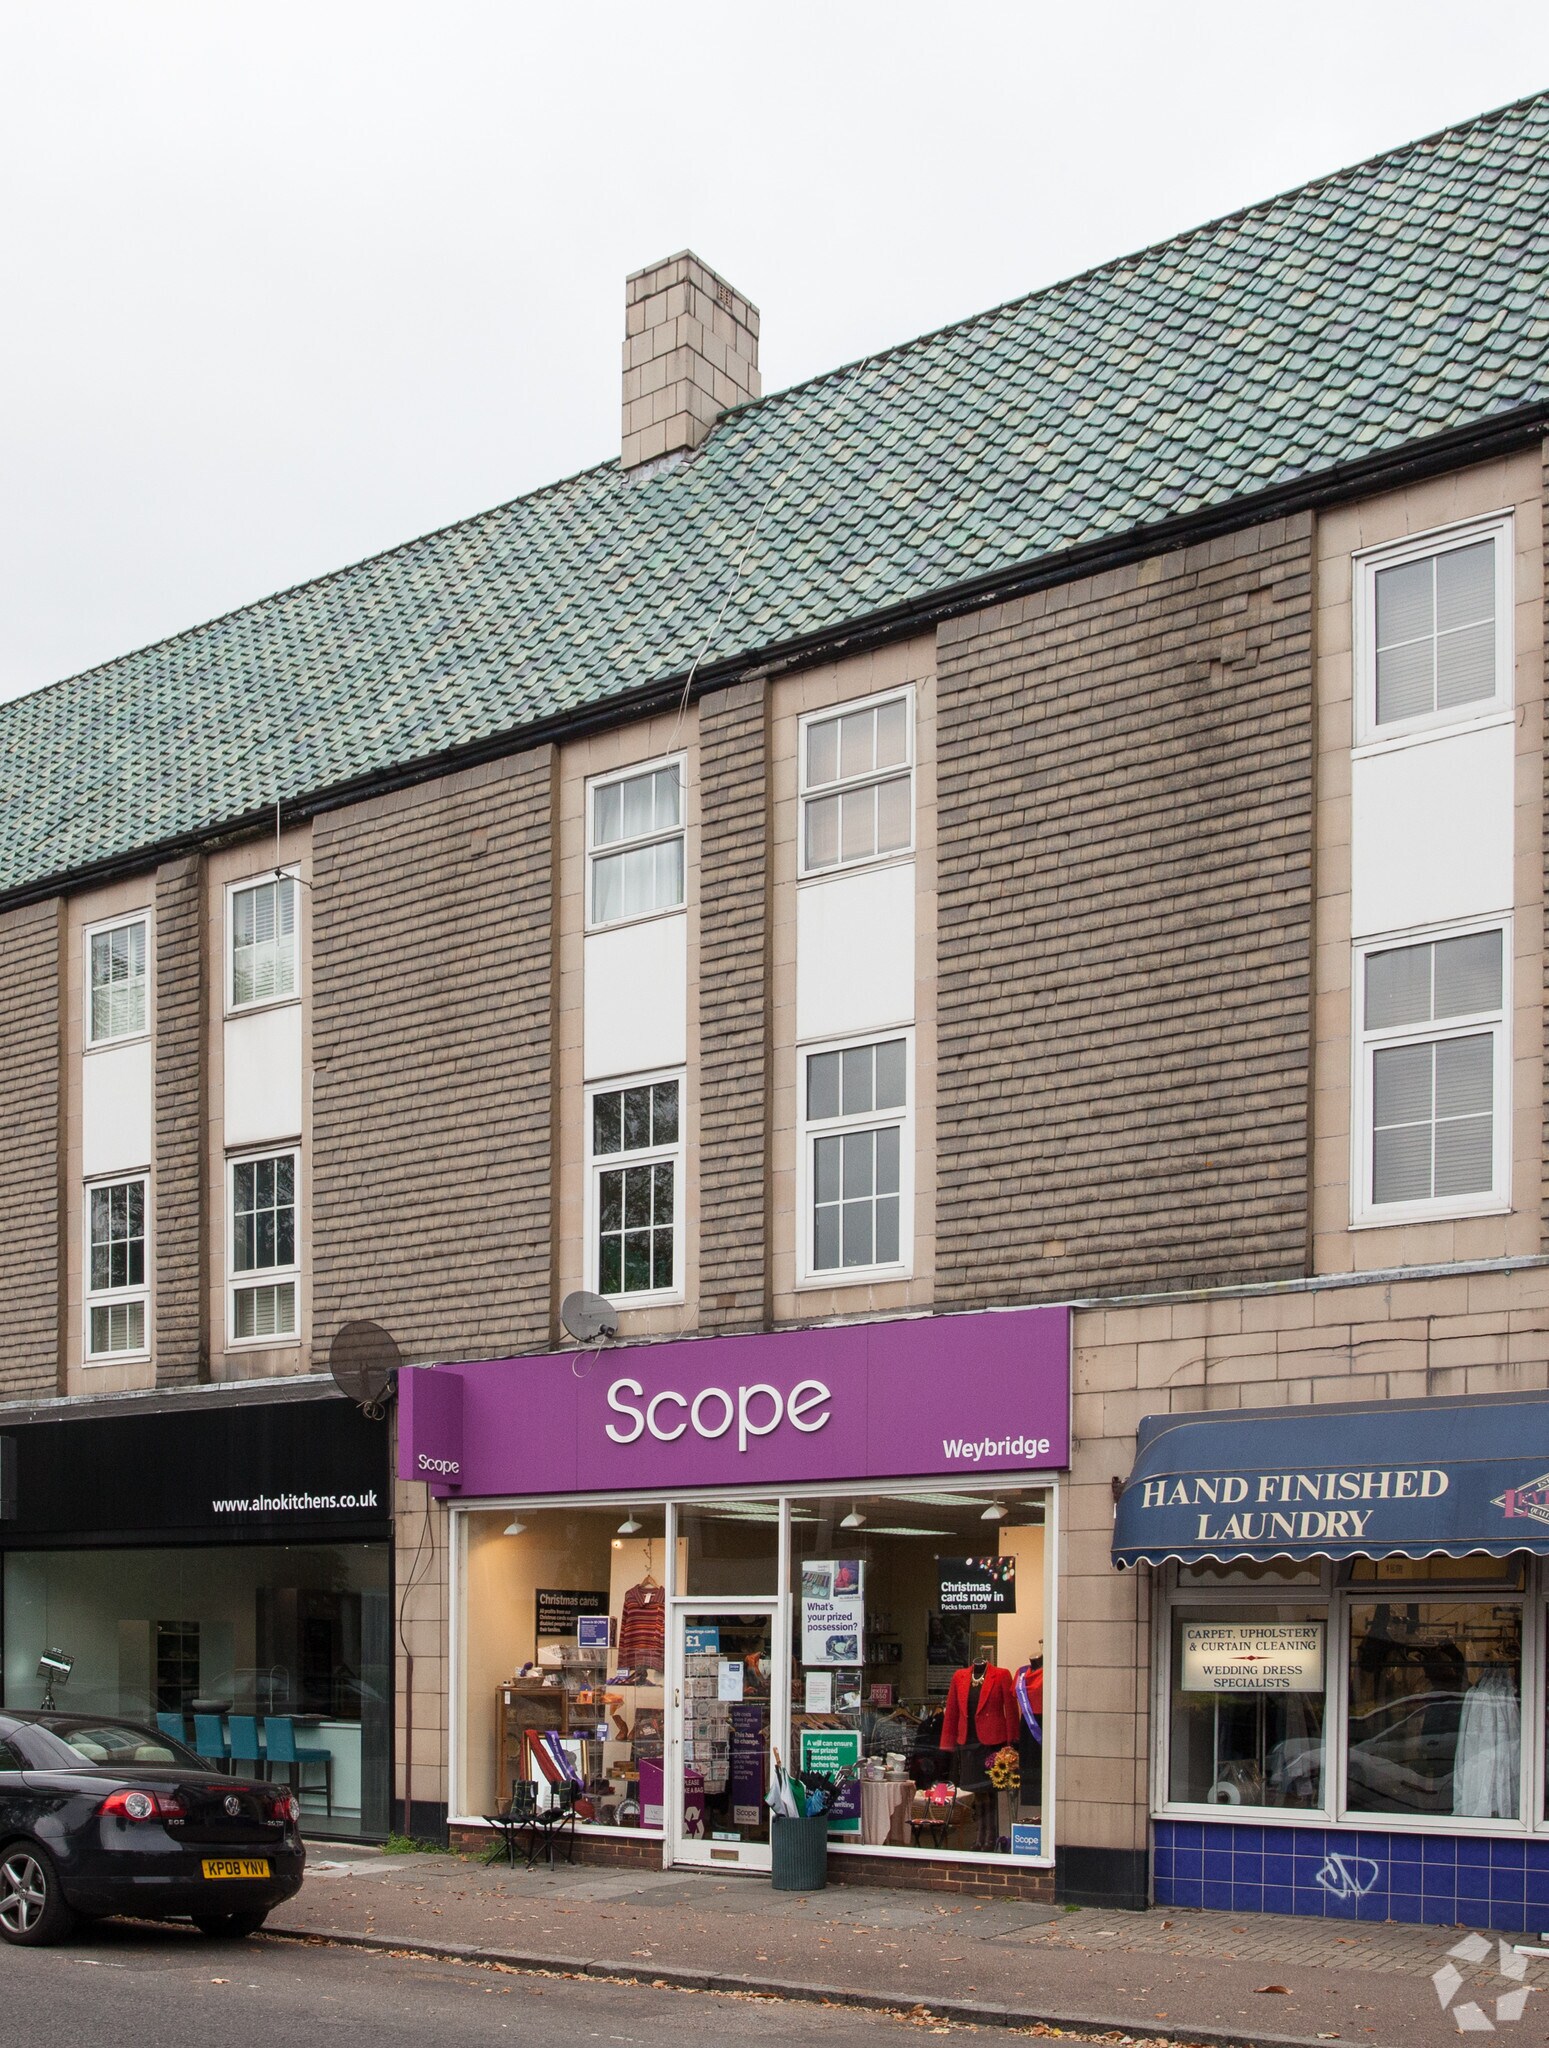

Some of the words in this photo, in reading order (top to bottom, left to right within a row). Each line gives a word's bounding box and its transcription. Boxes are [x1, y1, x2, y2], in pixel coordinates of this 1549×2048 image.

[605, 1378, 832, 1452] Scope
[942, 1435, 1050, 1462] Weybridge
[418, 1453, 460, 1476] Scope
[1141, 1475, 1249, 1509] HAND
[1254, 1469, 1449, 1503] FINISHED
[212, 1489, 378, 1513] www.alnokitchens.co.uk
[1194, 1509, 1374, 1541] LAUNDRY
[941, 1581, 991, 1592] Christmas
[540, 1593, 578, 1606] Christmas
[580, 1595, 599, 1607] cards
[941, 1592, 969, 1602] cards
[970, 1593, 992, 1602] now
[994, 1591, 1004, 1602] in
[807, 1602, 834, 1611] What's
[807, 1613, 826, 1623] your
[827, 1612, 853, 1622] prized
[807, 1622, 858, 1632] possession?
[1240, 1628, 1319, 1639] UPHOLSTERY
[686, 1635, 701, 1647] £1
[1189, 1642, 1197, 1651] &
[1201, 1641, 1252, 1651] CURTAIN
[1256, 1640, 1317, 1651] CLEANING
[1203, 1665, 1258, 1675] WEDDING
[1263, 1665, 1303, 1675] DRESS
[1213, 1678, 1290, 1688] SPECIALISTS
[820, 1747, 838, 1755] prized
[736, 1808, 757, 1818] Scope
[1014, 1834, 1039, 1845] Scope
[208, 1861, 241, 1876] KP08
[244, 1861, 265, 1875] YNV
